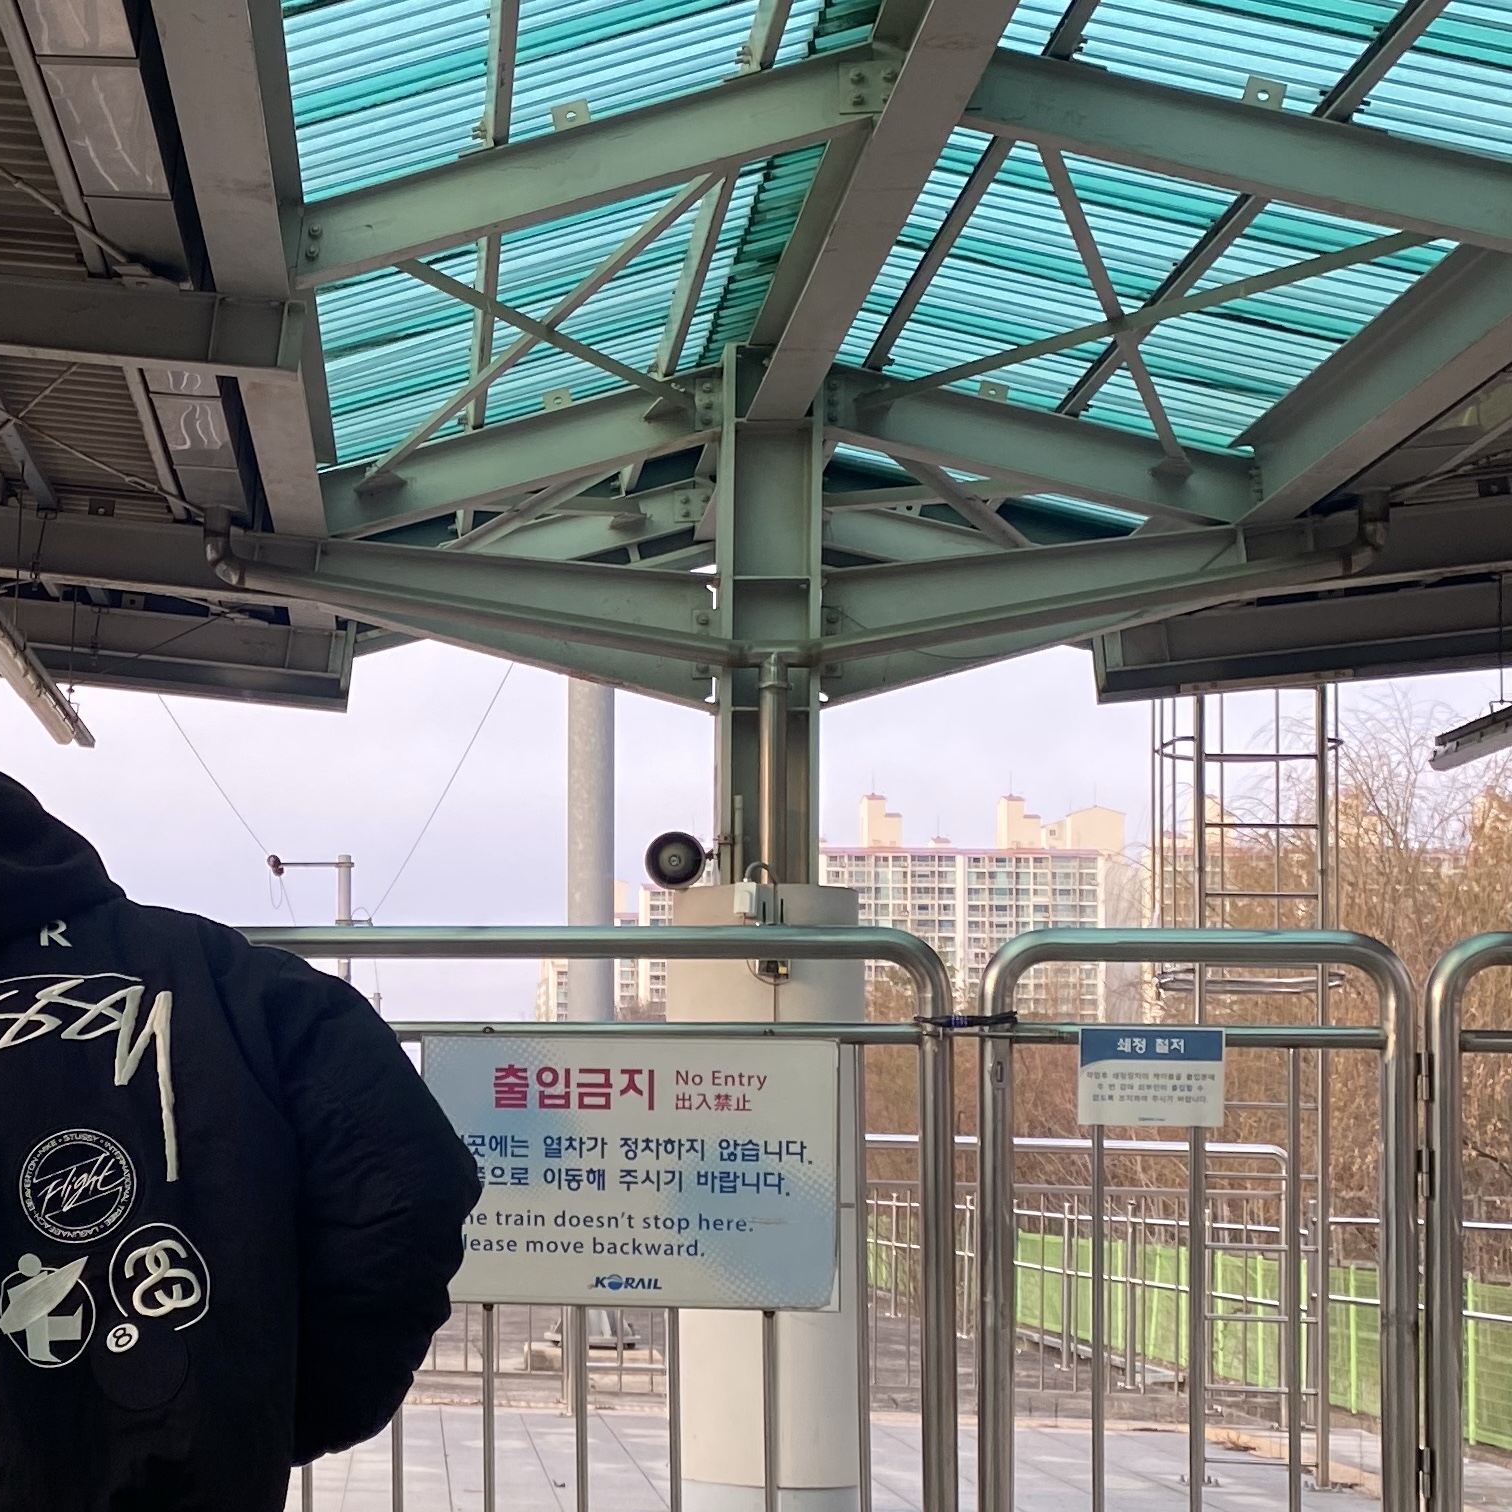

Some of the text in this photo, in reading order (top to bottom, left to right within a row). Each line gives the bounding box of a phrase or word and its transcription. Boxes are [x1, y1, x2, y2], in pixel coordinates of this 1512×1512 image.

[1117, 1037, 1185, 1054] 쇄정 철저
[493, 1064, 655, 1111] 출입금지
[675, 1070, 767, 1091] No Entry
[675, 1092, 752, 1112] 出入禁止
[460, 1134, 813, 1165] 곳에는 열차가 정차하지 않습니다.
[543, 1167, 606, 1191] 이동해
[619, 1169, 683, 1193] 주시기
[696, 1171, 790, 1196] 바랍니다.
[495, 1210, 546, 1227] train
[554, 1210, 635, 1229] doesn't
[642, 1214, 690, 1234] stop
[698, 1213, 754, 1232] here.
[463, 1233, 705, 1257] lease move backward.
[594, 1274, 662, 1291] KORAIL
